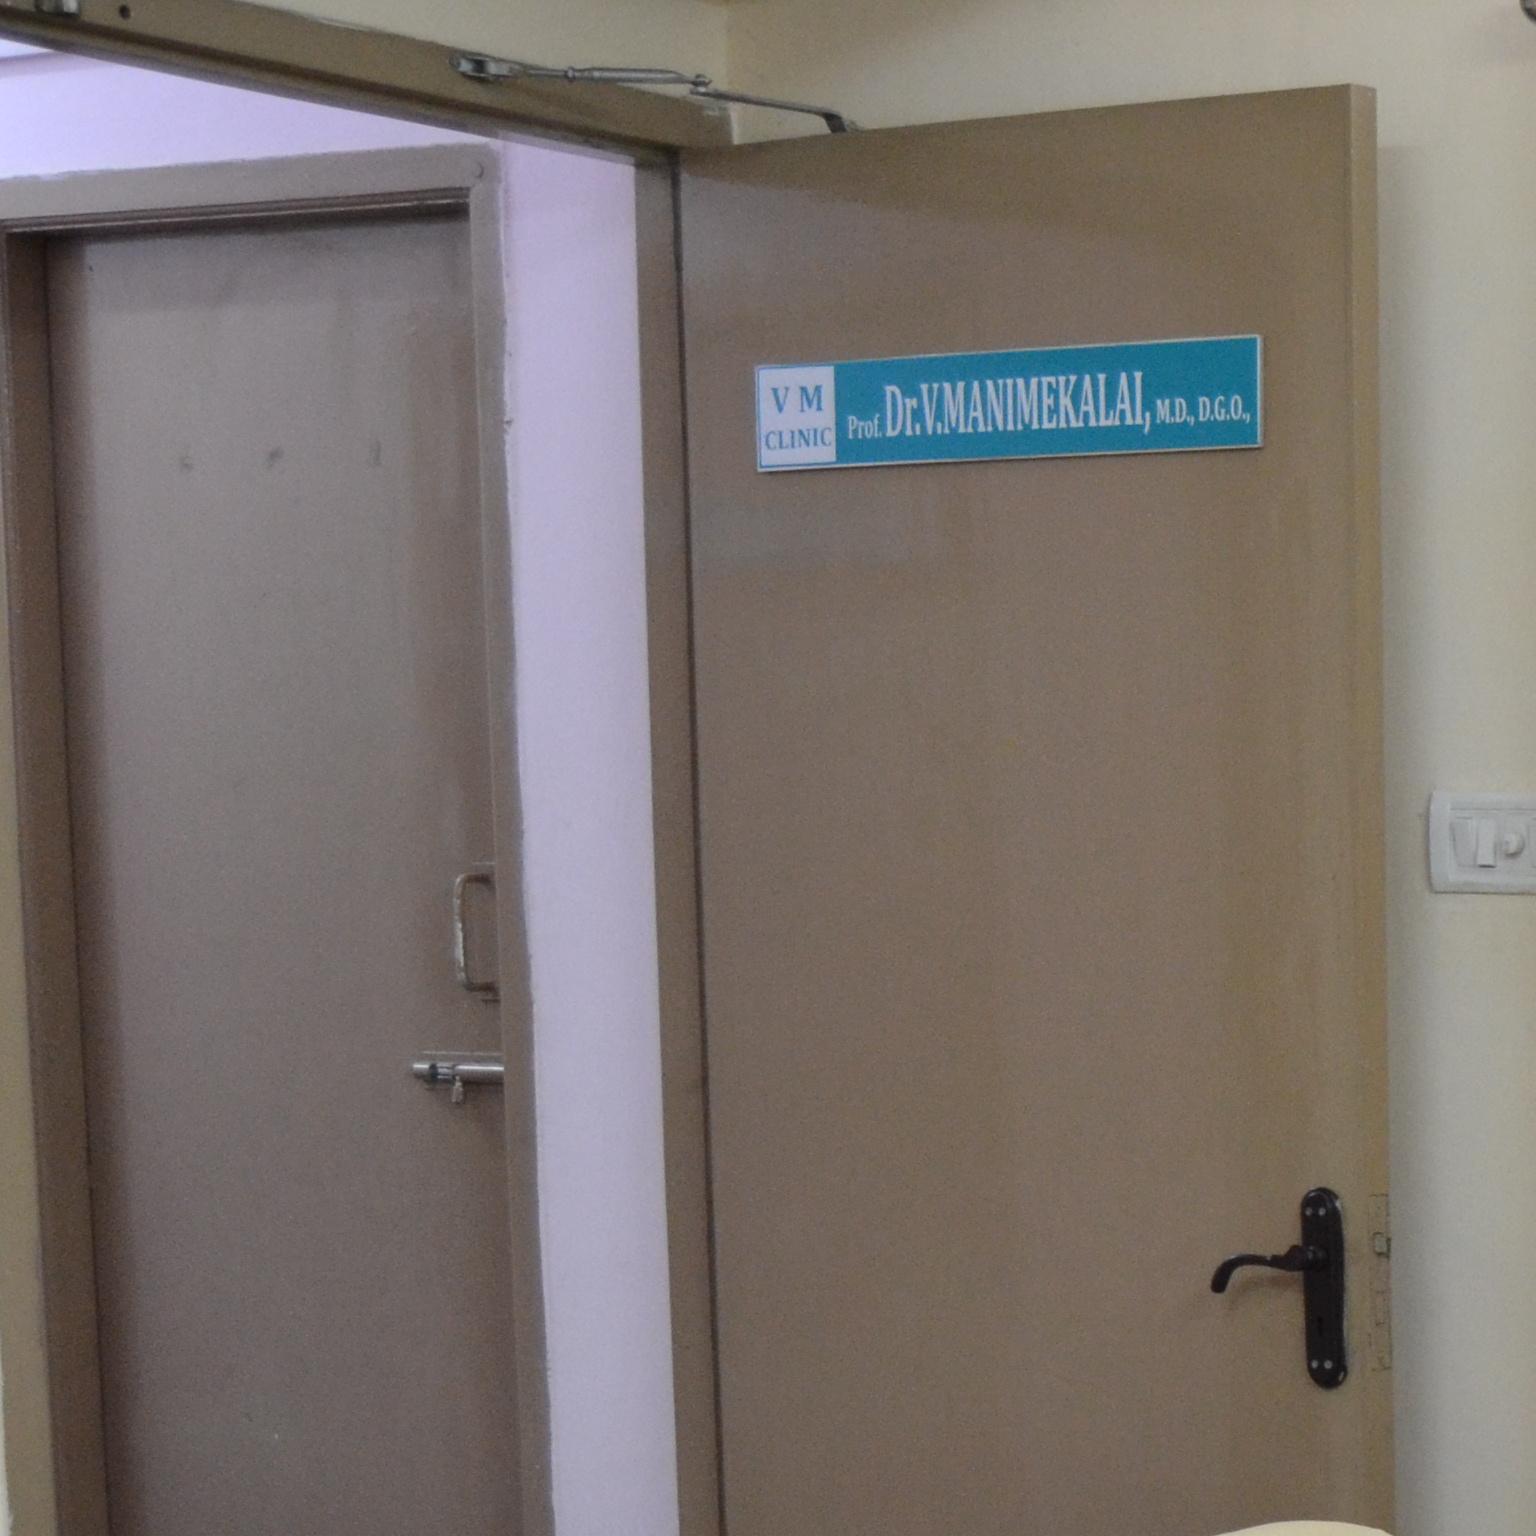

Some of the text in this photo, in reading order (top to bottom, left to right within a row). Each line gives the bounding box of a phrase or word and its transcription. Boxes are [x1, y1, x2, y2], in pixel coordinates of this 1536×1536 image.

[770, 384, 824, 415] V M
[764, 427, 833, 452] CLINIC
[847, 414, 882, 440] Prof.
